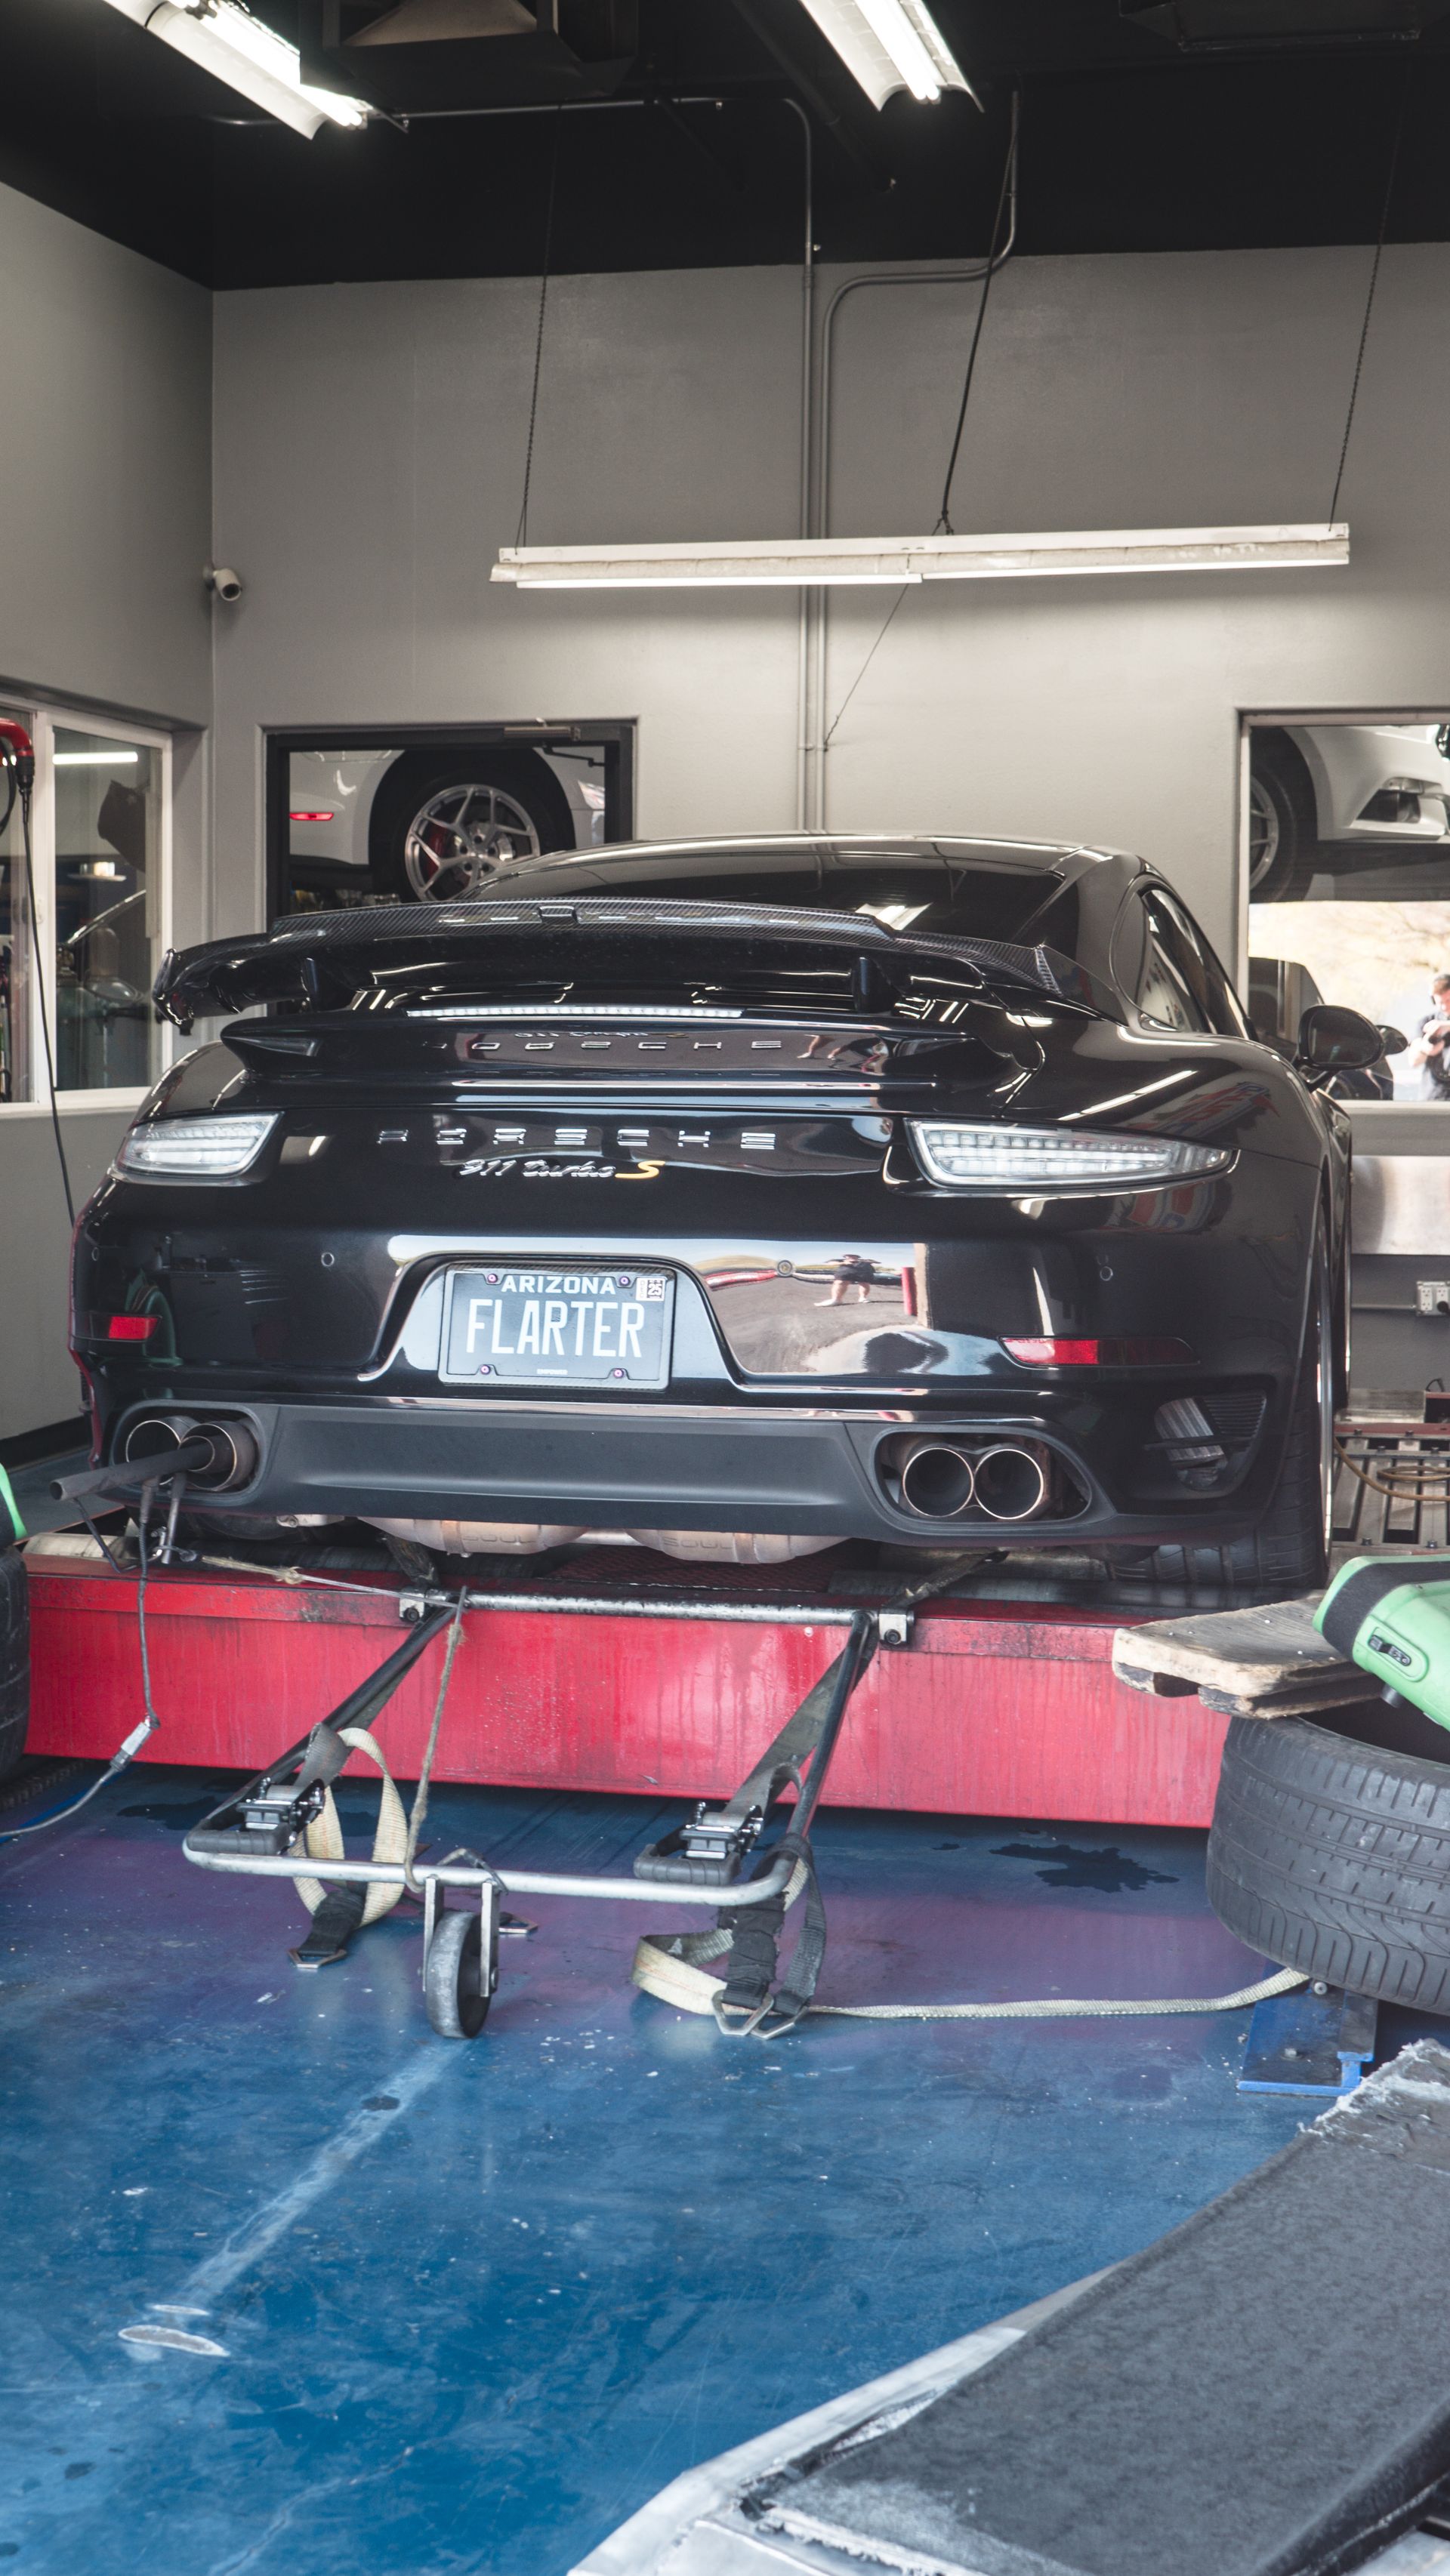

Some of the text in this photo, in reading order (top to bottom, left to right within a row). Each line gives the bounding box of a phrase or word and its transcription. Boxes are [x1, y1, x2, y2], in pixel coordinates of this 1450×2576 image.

[378, 1127, 776, 1150] PORSCHE
[460, 1159, 517, 1176] 911
[614, 1160, 665, 1179] S
[501, 1275, 616, 1295] ARIZONA
[647, 1283, 662, 1296] 25
[466, 1299, 645, 1358] FLARTER
[664, 1536, 734, 1550] SOUL
